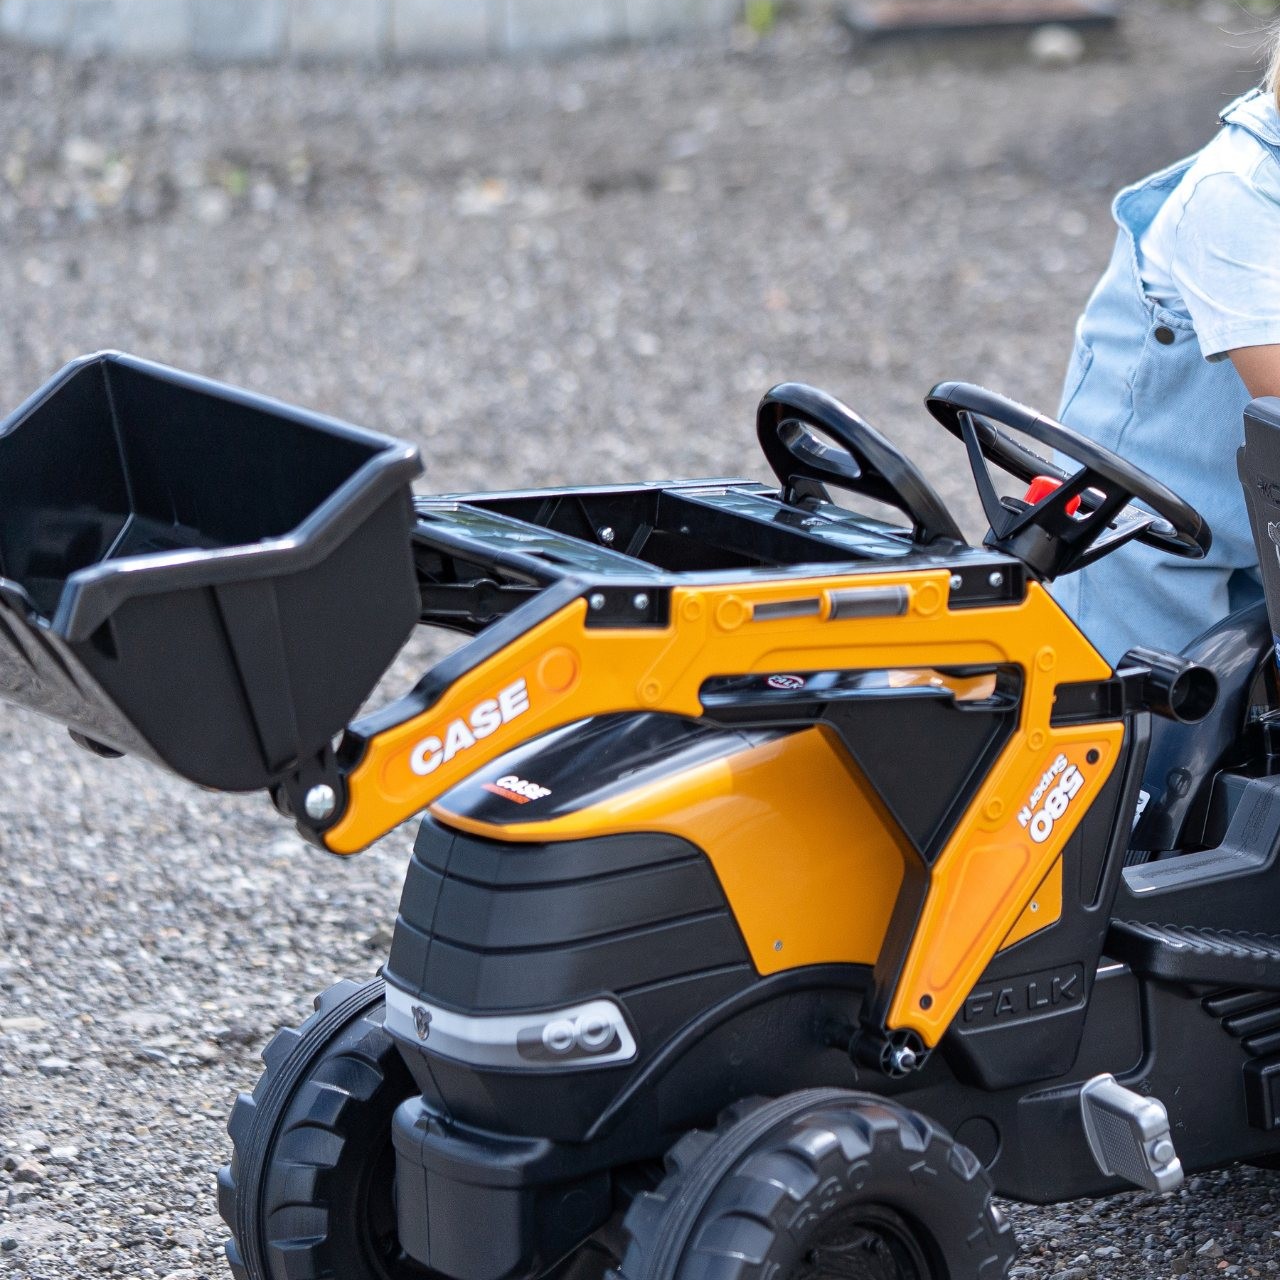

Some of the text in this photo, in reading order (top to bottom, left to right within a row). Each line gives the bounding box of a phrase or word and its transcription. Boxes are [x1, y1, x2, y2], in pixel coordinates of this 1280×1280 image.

[410, 677, 530, 776] CASE
[496, 775, 553, 800] CASE
[1017, 753, 1068, 829] Super N
[1029, 764, 1085, 843] 580
[963, 972, 1077, 1023] FALK
